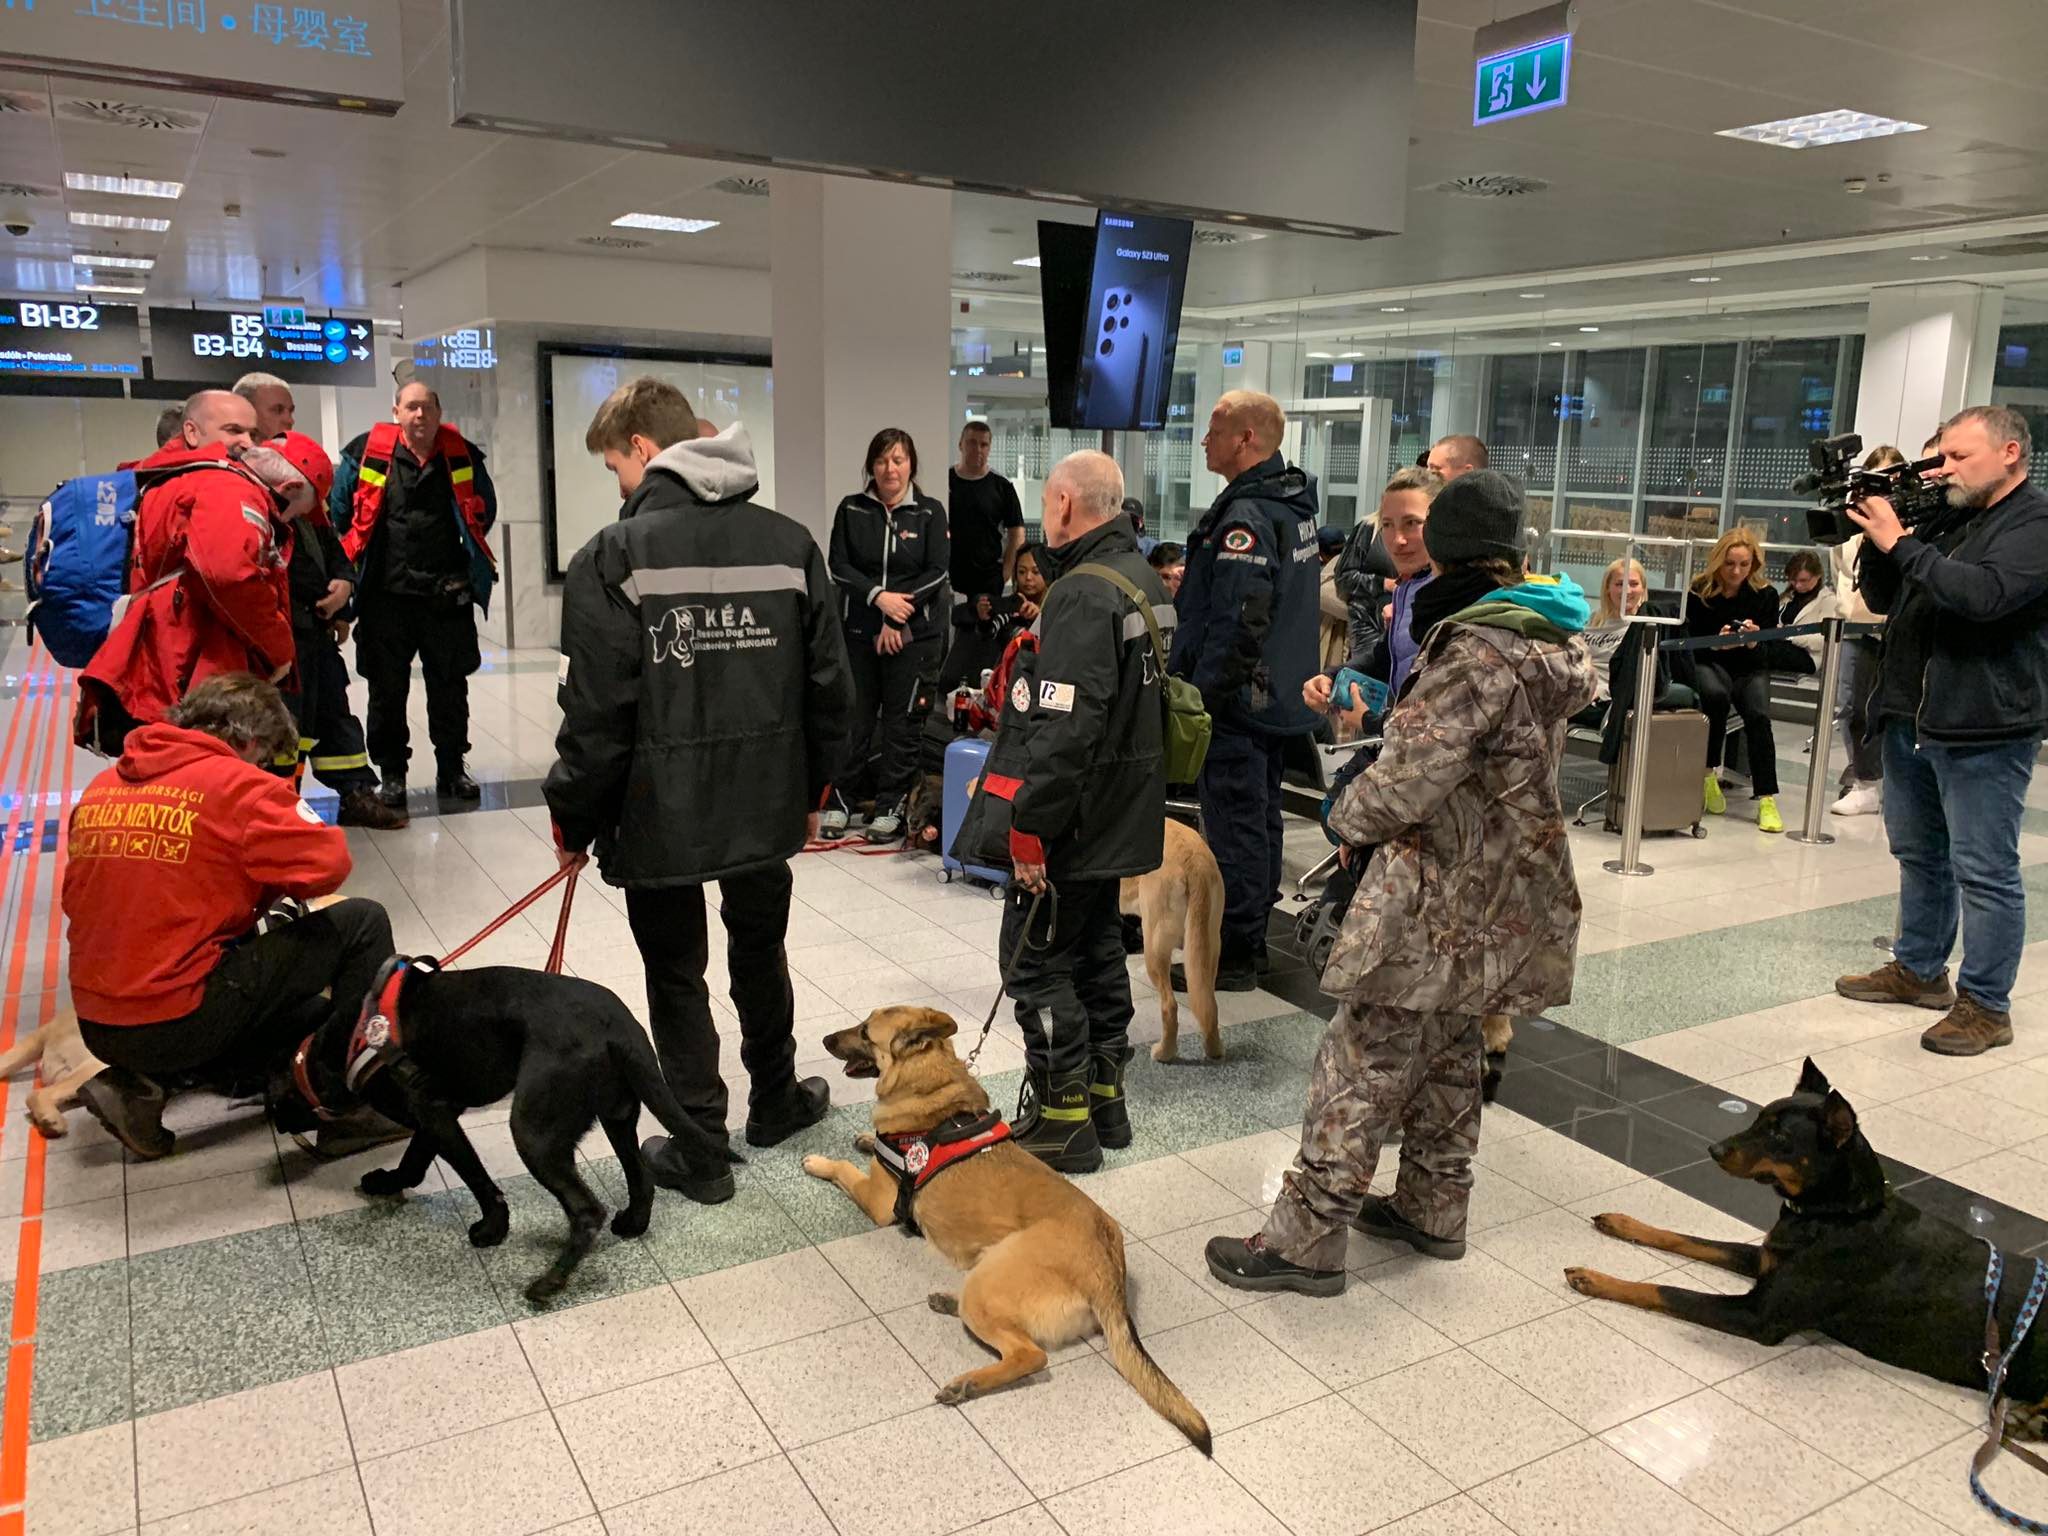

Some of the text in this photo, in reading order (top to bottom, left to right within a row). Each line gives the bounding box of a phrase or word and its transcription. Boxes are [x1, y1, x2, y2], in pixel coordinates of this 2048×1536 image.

[252, 3, 373, 57] 母婴室
[1104, 217, 1134, 228] SAMSUNG
[1116, 248, 1141, 261] Galaxy
[1153, 252, 1170, 262] Ultra
[20, 302, 99, 330] B1-B2
[231, 314, 264, 337] B5
[193, 333, 264, 358] B3-B4
[725, 628, 744, 638] Dog
[745, 627, 771, 637] Team
[736, 637, 778, 649] HUNGARY
[122, 800, 199, 836] MENTŐK
